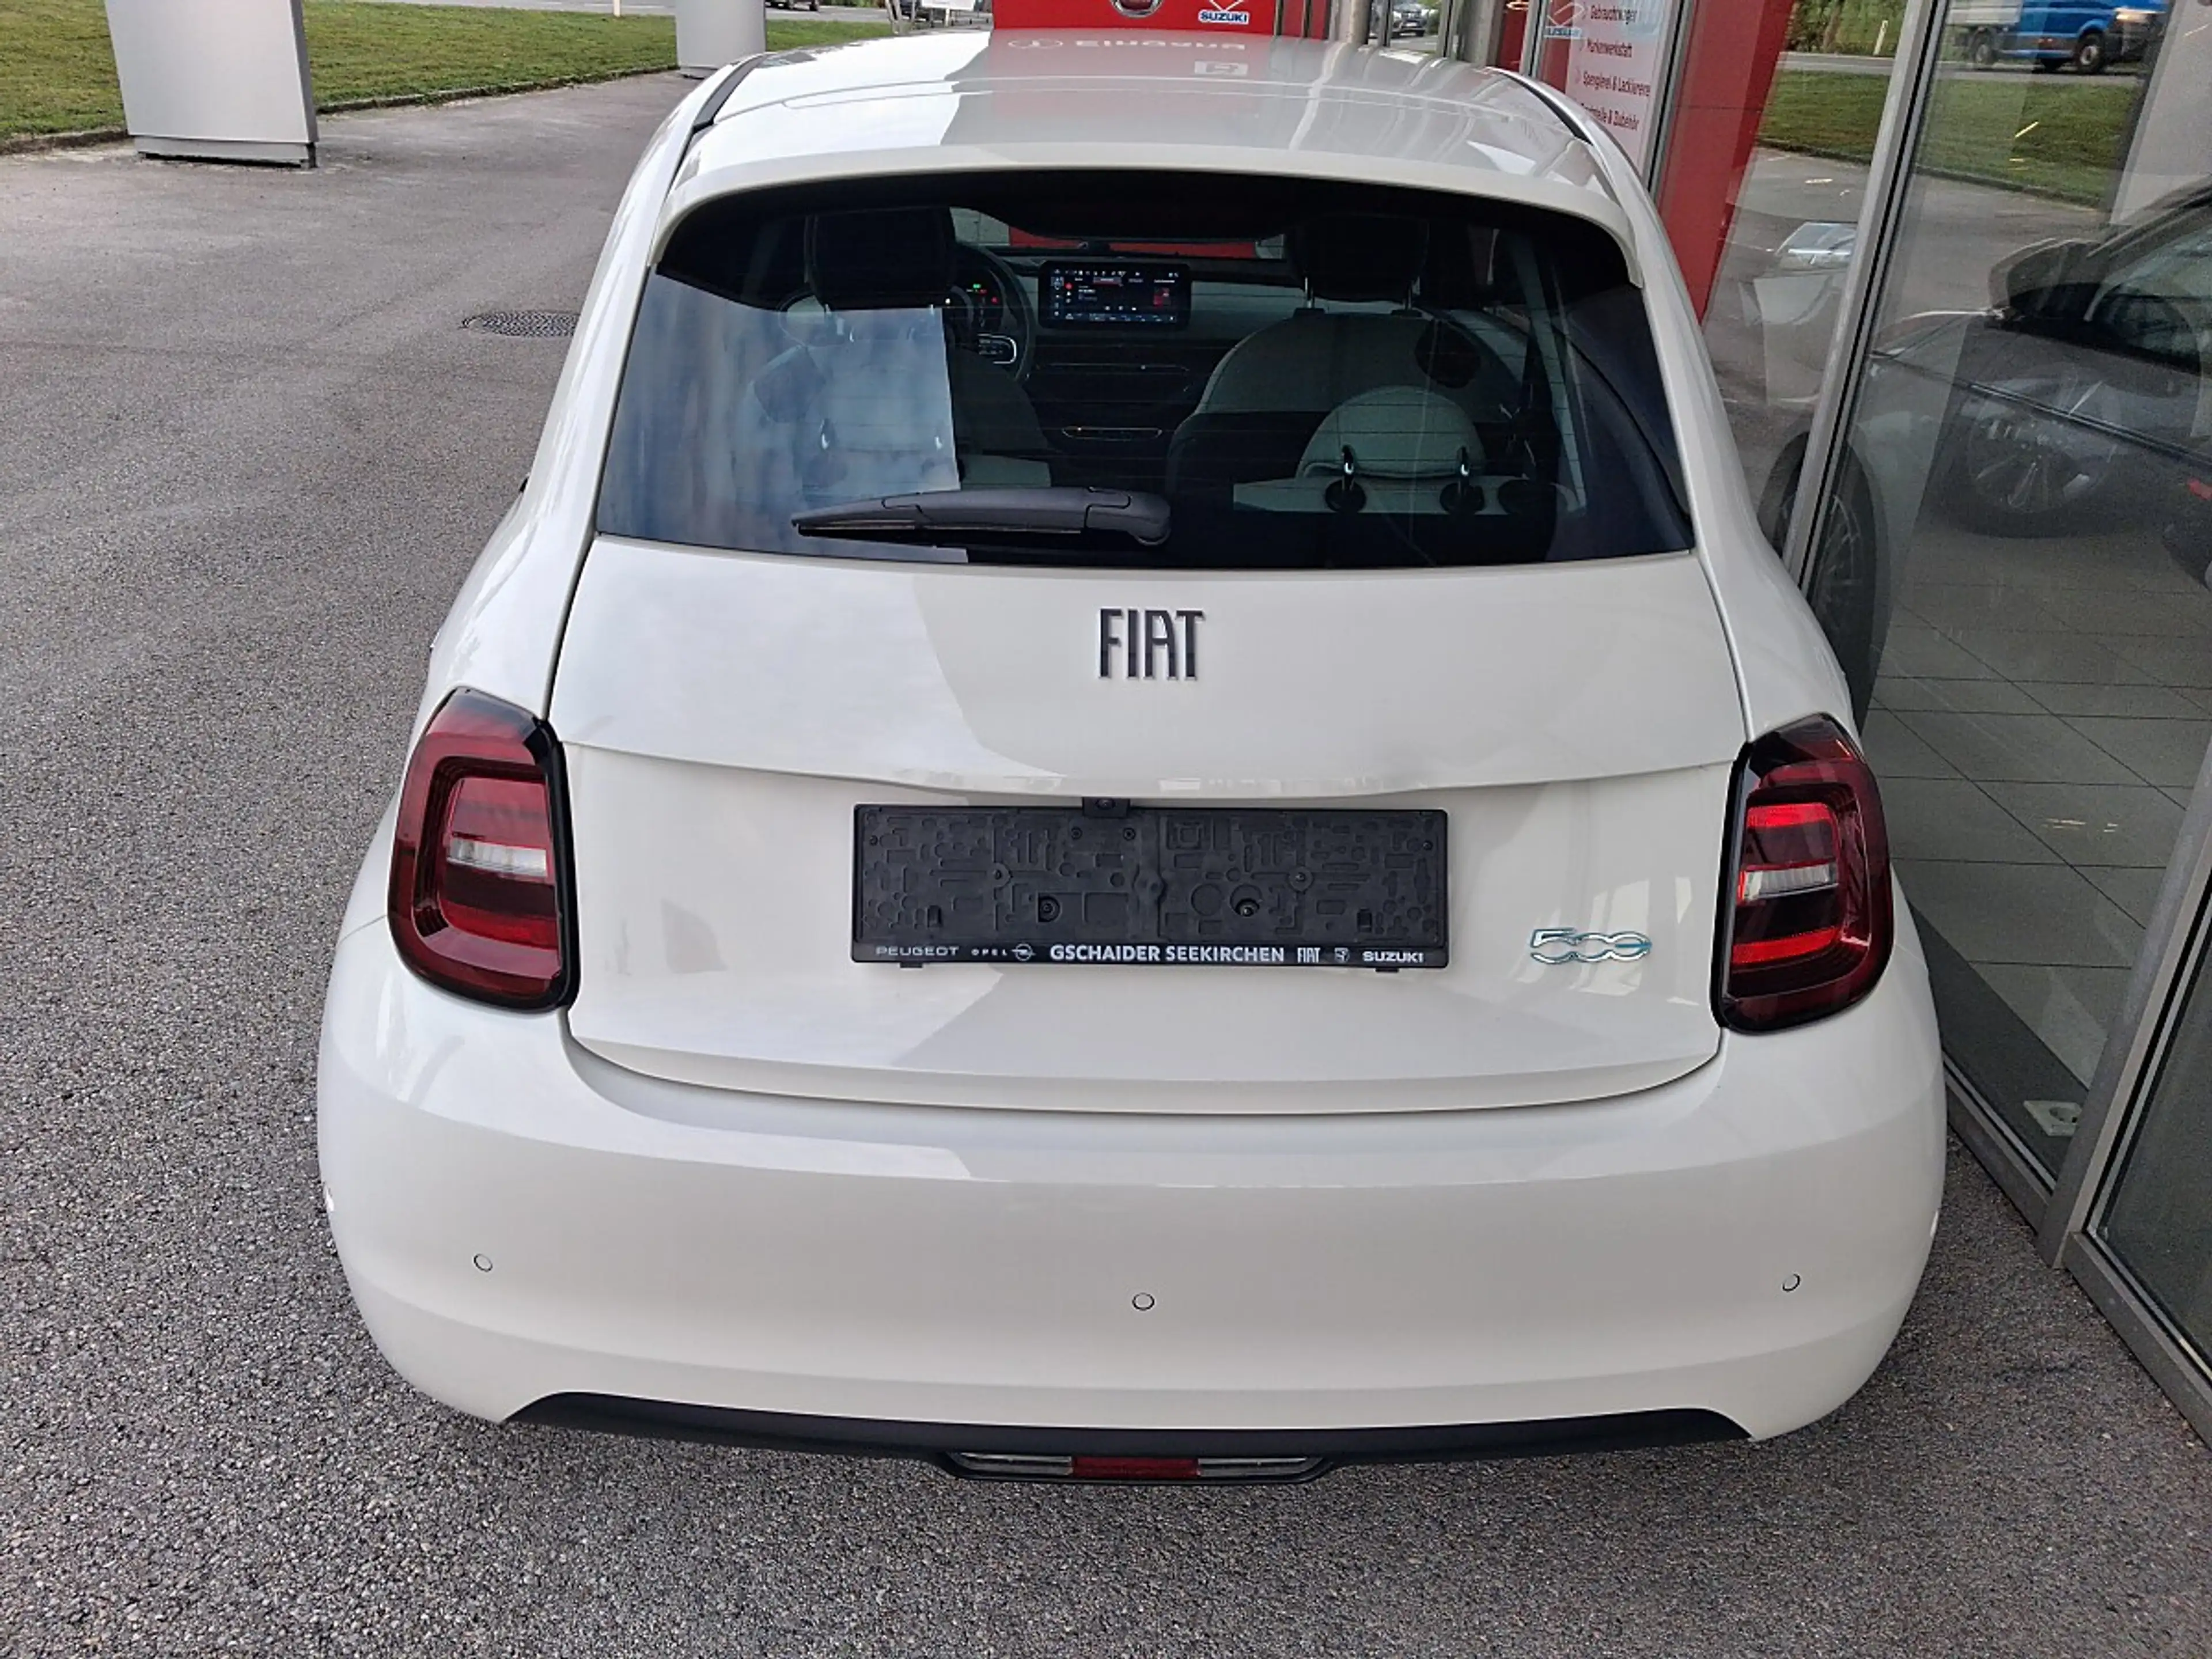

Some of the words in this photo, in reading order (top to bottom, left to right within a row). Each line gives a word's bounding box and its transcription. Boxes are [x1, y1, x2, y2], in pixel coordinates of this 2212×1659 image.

[1200, 11, 1247, 22] SUZUKI
[1100, 608, 1205, 680] FIAT
[876, 946, 959, 956] PEUGEOT
[972, 948, 1008, 956] OPEL
[1050, 945, 1161, 961] GSCHAIDER
[1165, 946, 1285, 962] SEEKIRCHEN
[1297, 948, 1320, 963] FIAT
[1362, 951, 1424, 963] SUZUKI
[1531, 927, 1652, 964] 500
